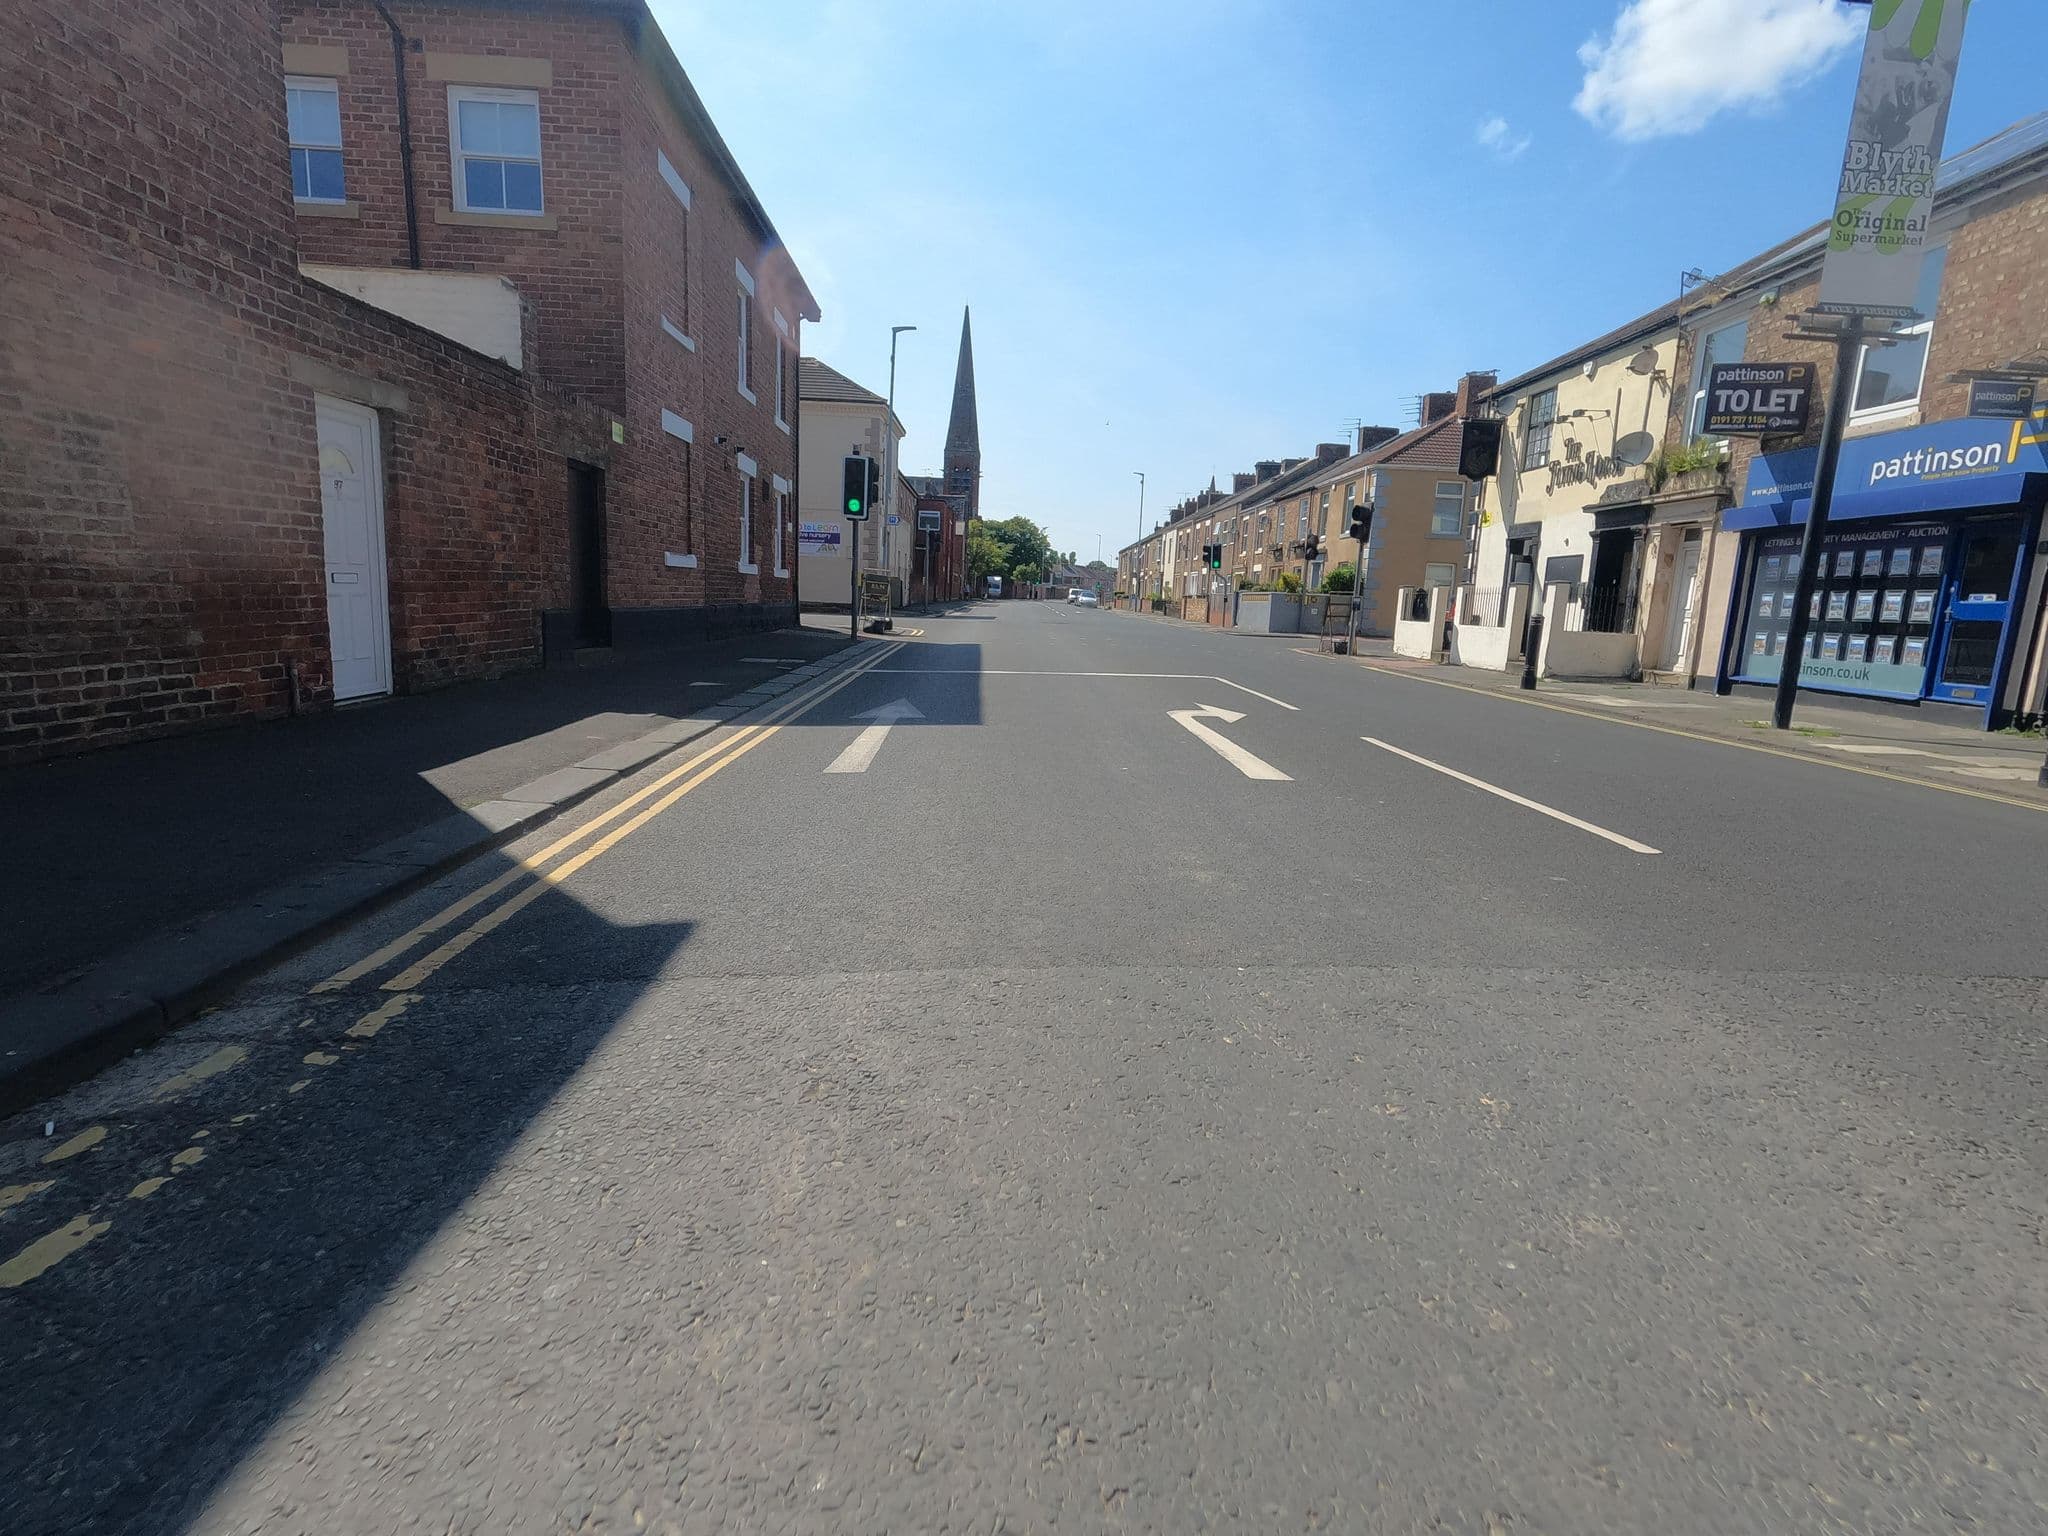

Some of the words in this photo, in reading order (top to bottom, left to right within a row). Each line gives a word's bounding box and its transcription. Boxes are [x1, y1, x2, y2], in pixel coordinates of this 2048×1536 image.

[1845, 140, 1933, 181] Blyth
[1840, 170, 1935, 198] Market
[1836, 209, 1928, 234] Original
[1835, 230, 1924, 246] Supermarket
[1717, 368, 1784, 384] pattinson
[1715, 389, 1750, 412] TO
[1752, 388, 1805, 412] LET
[1975, 391, 2016, 402] pattinson
[1711, 416, 1730, 424] 0191
[1870, 443, 2002, 486] pattinson
[1751, 482, 1813, 496] www.pattinson.co
[1764, 537, 1794, 548] LETTINGS
[1840, 531, 1900, 542] MANAGEMENT
[1907, 526, 1950, 538] AUCTION
[1801, 662, 1870, 680] inson.co.uk
